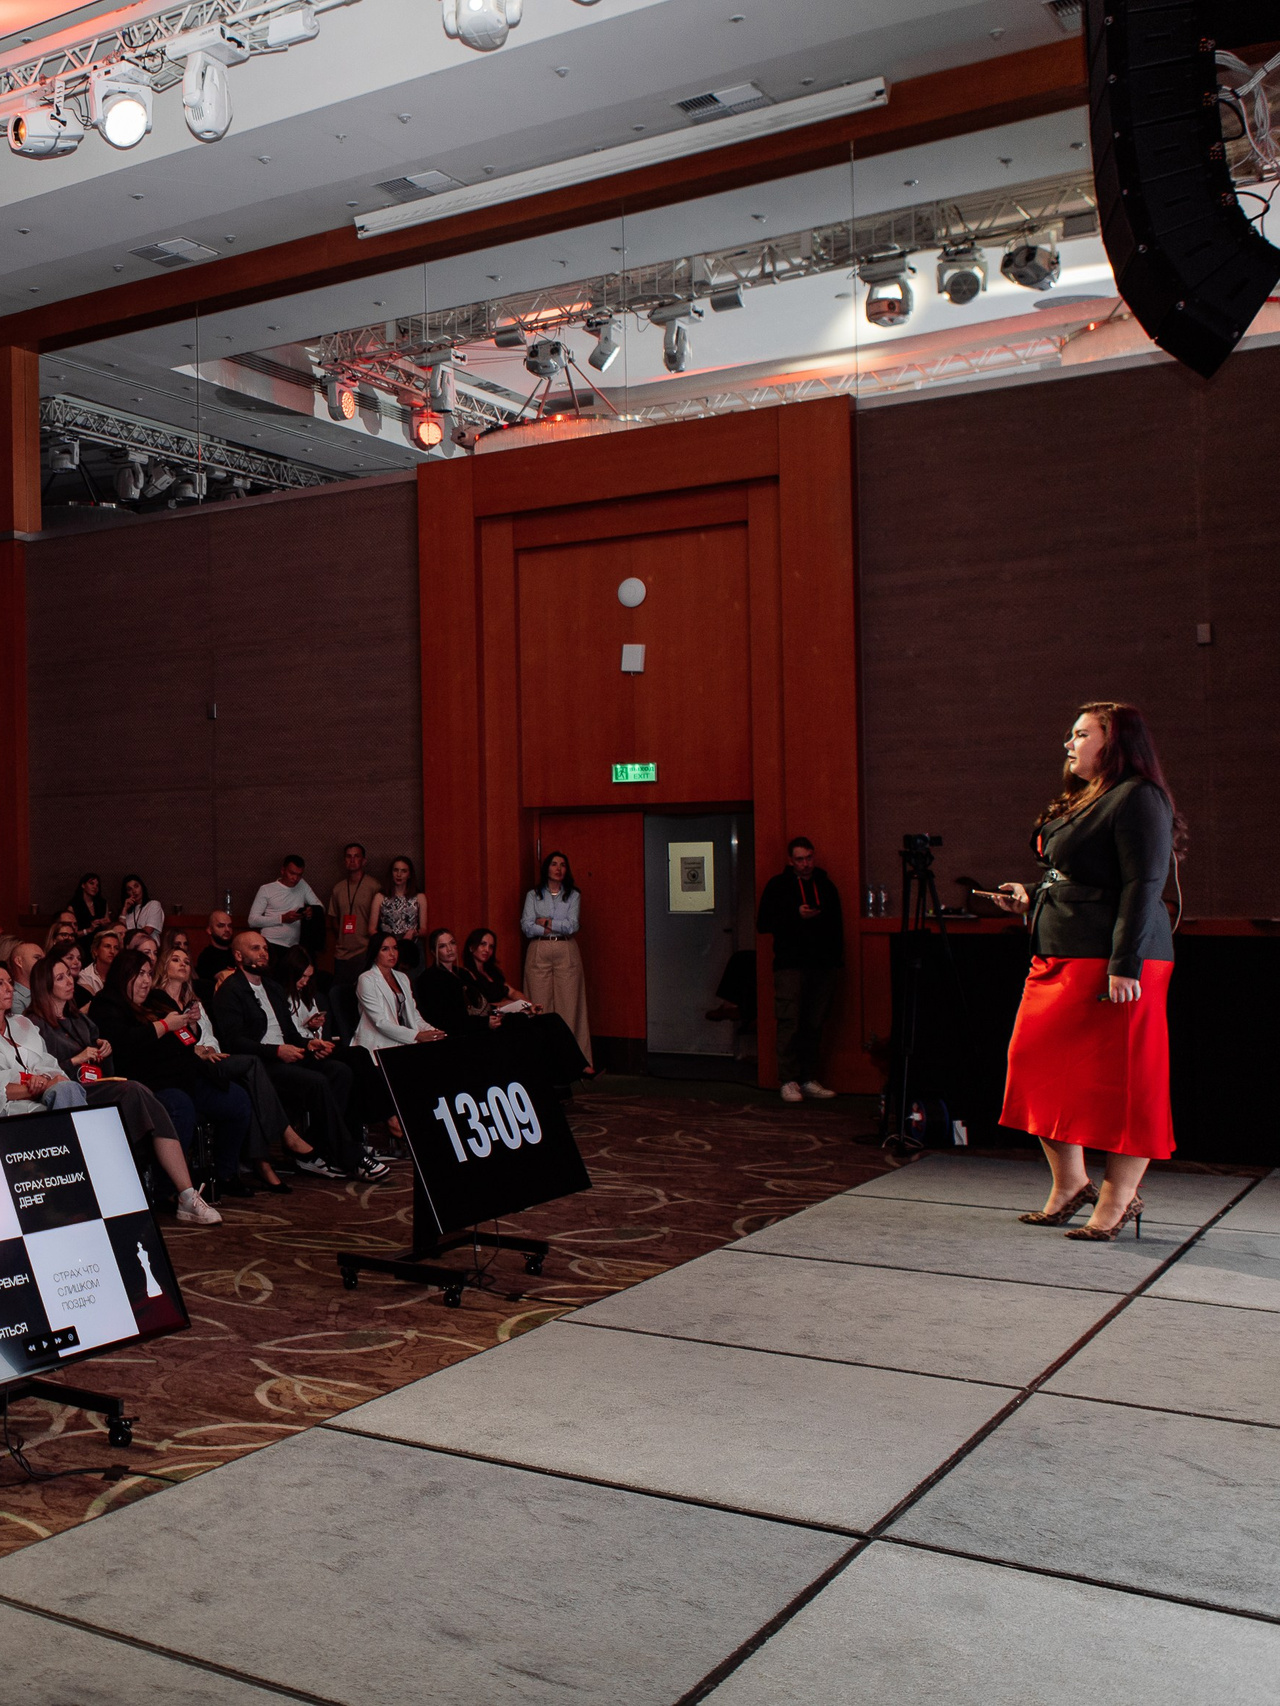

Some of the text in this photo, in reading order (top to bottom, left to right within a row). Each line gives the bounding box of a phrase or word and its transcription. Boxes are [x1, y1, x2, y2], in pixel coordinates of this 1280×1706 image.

[433, 1082, 542, 1163] 13:09
[5, 1144, 71, 1164] СТРАХ УСПЕХА
[14, 1171, 86, 1193] СТРАХ БОЛЬШИХ
[19, 1193, 45, 1209] ДЕНЕГ
[52, 1263, 100, 1283] СТРАХ ЧТО
[57, 1278, 100, 1297] СЛИШКОМ
[61, 1295, 96, 1311] ПОЗДНО
